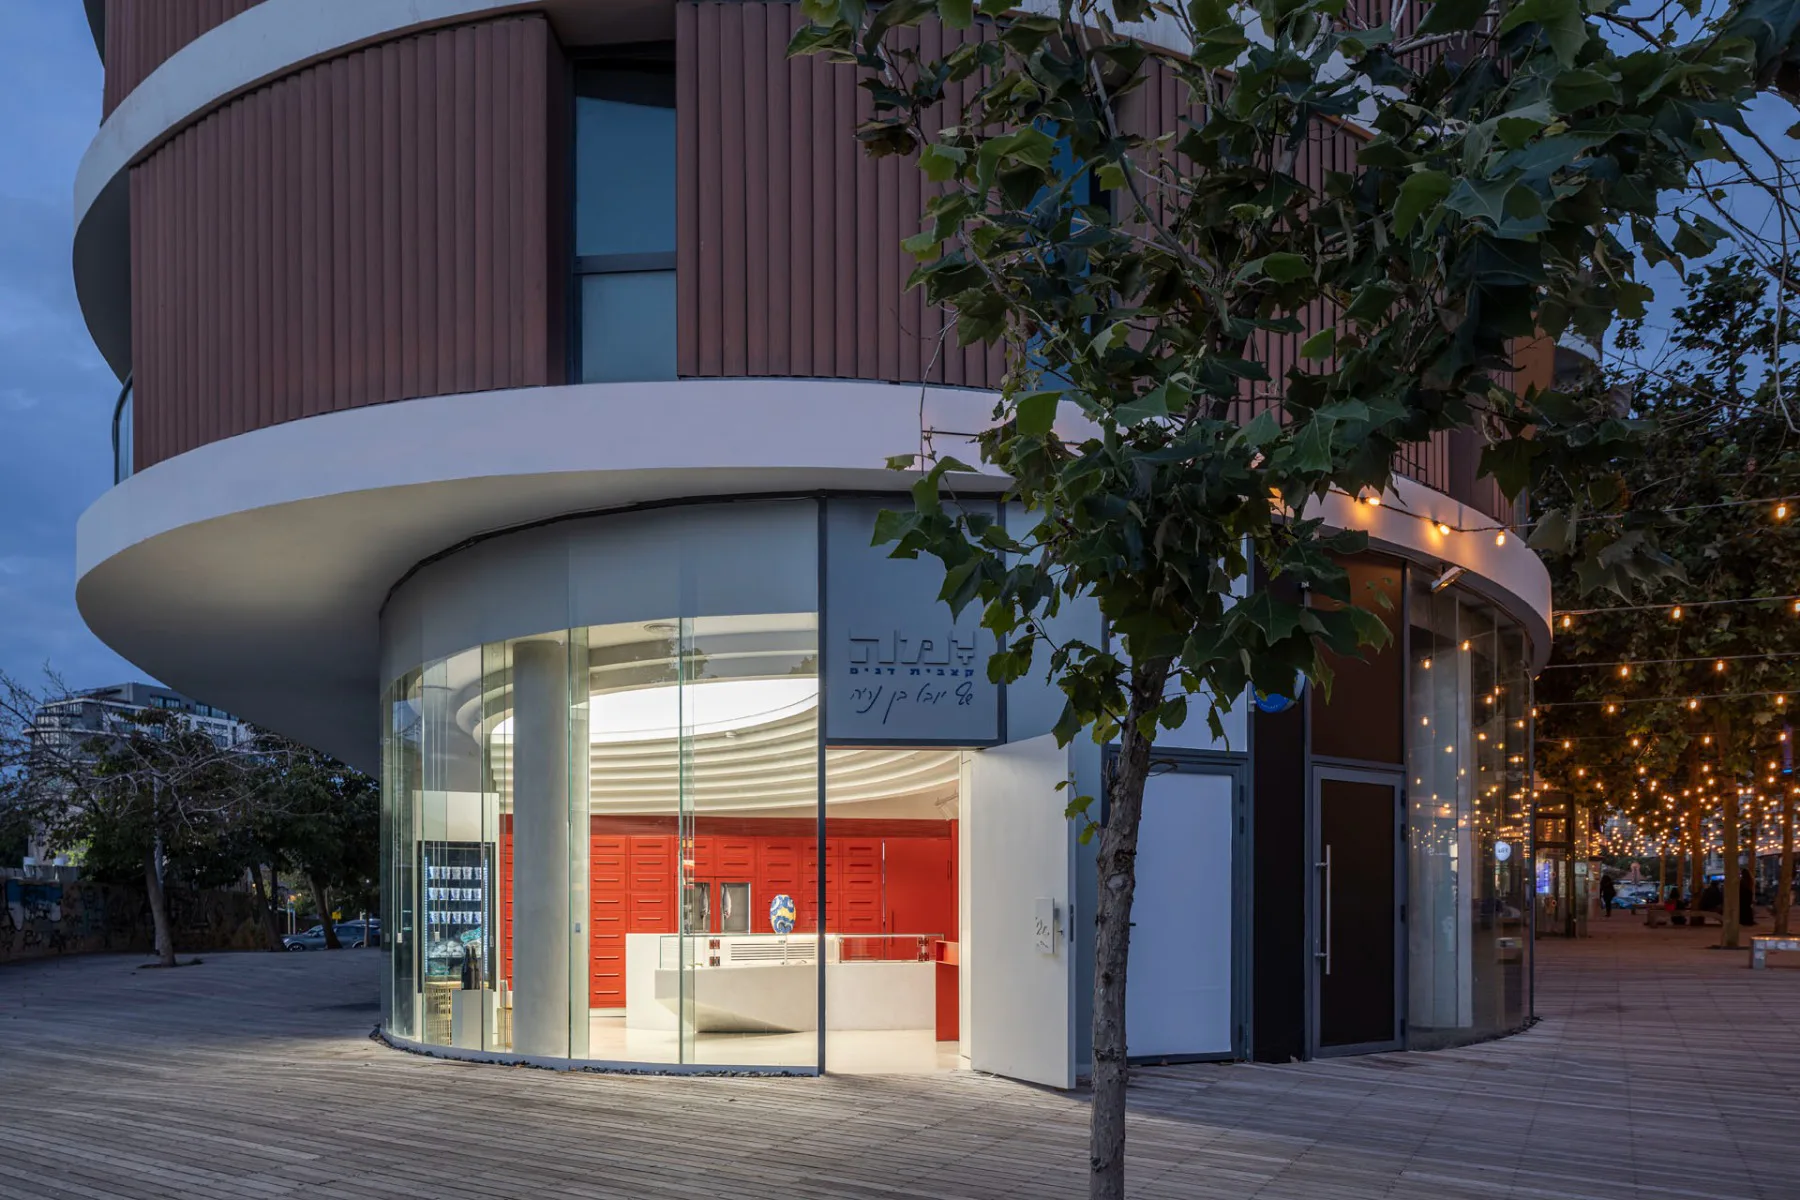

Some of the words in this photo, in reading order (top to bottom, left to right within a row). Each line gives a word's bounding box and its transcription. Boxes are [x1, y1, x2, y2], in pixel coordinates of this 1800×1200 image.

[849, 667, 896, 676] דגים
[909, 668, 975, 678] קצבית
[916, 682, 948, 705] יובל
[955, 681, 974, 706] שף
[883, 690, 909, 725] בן
